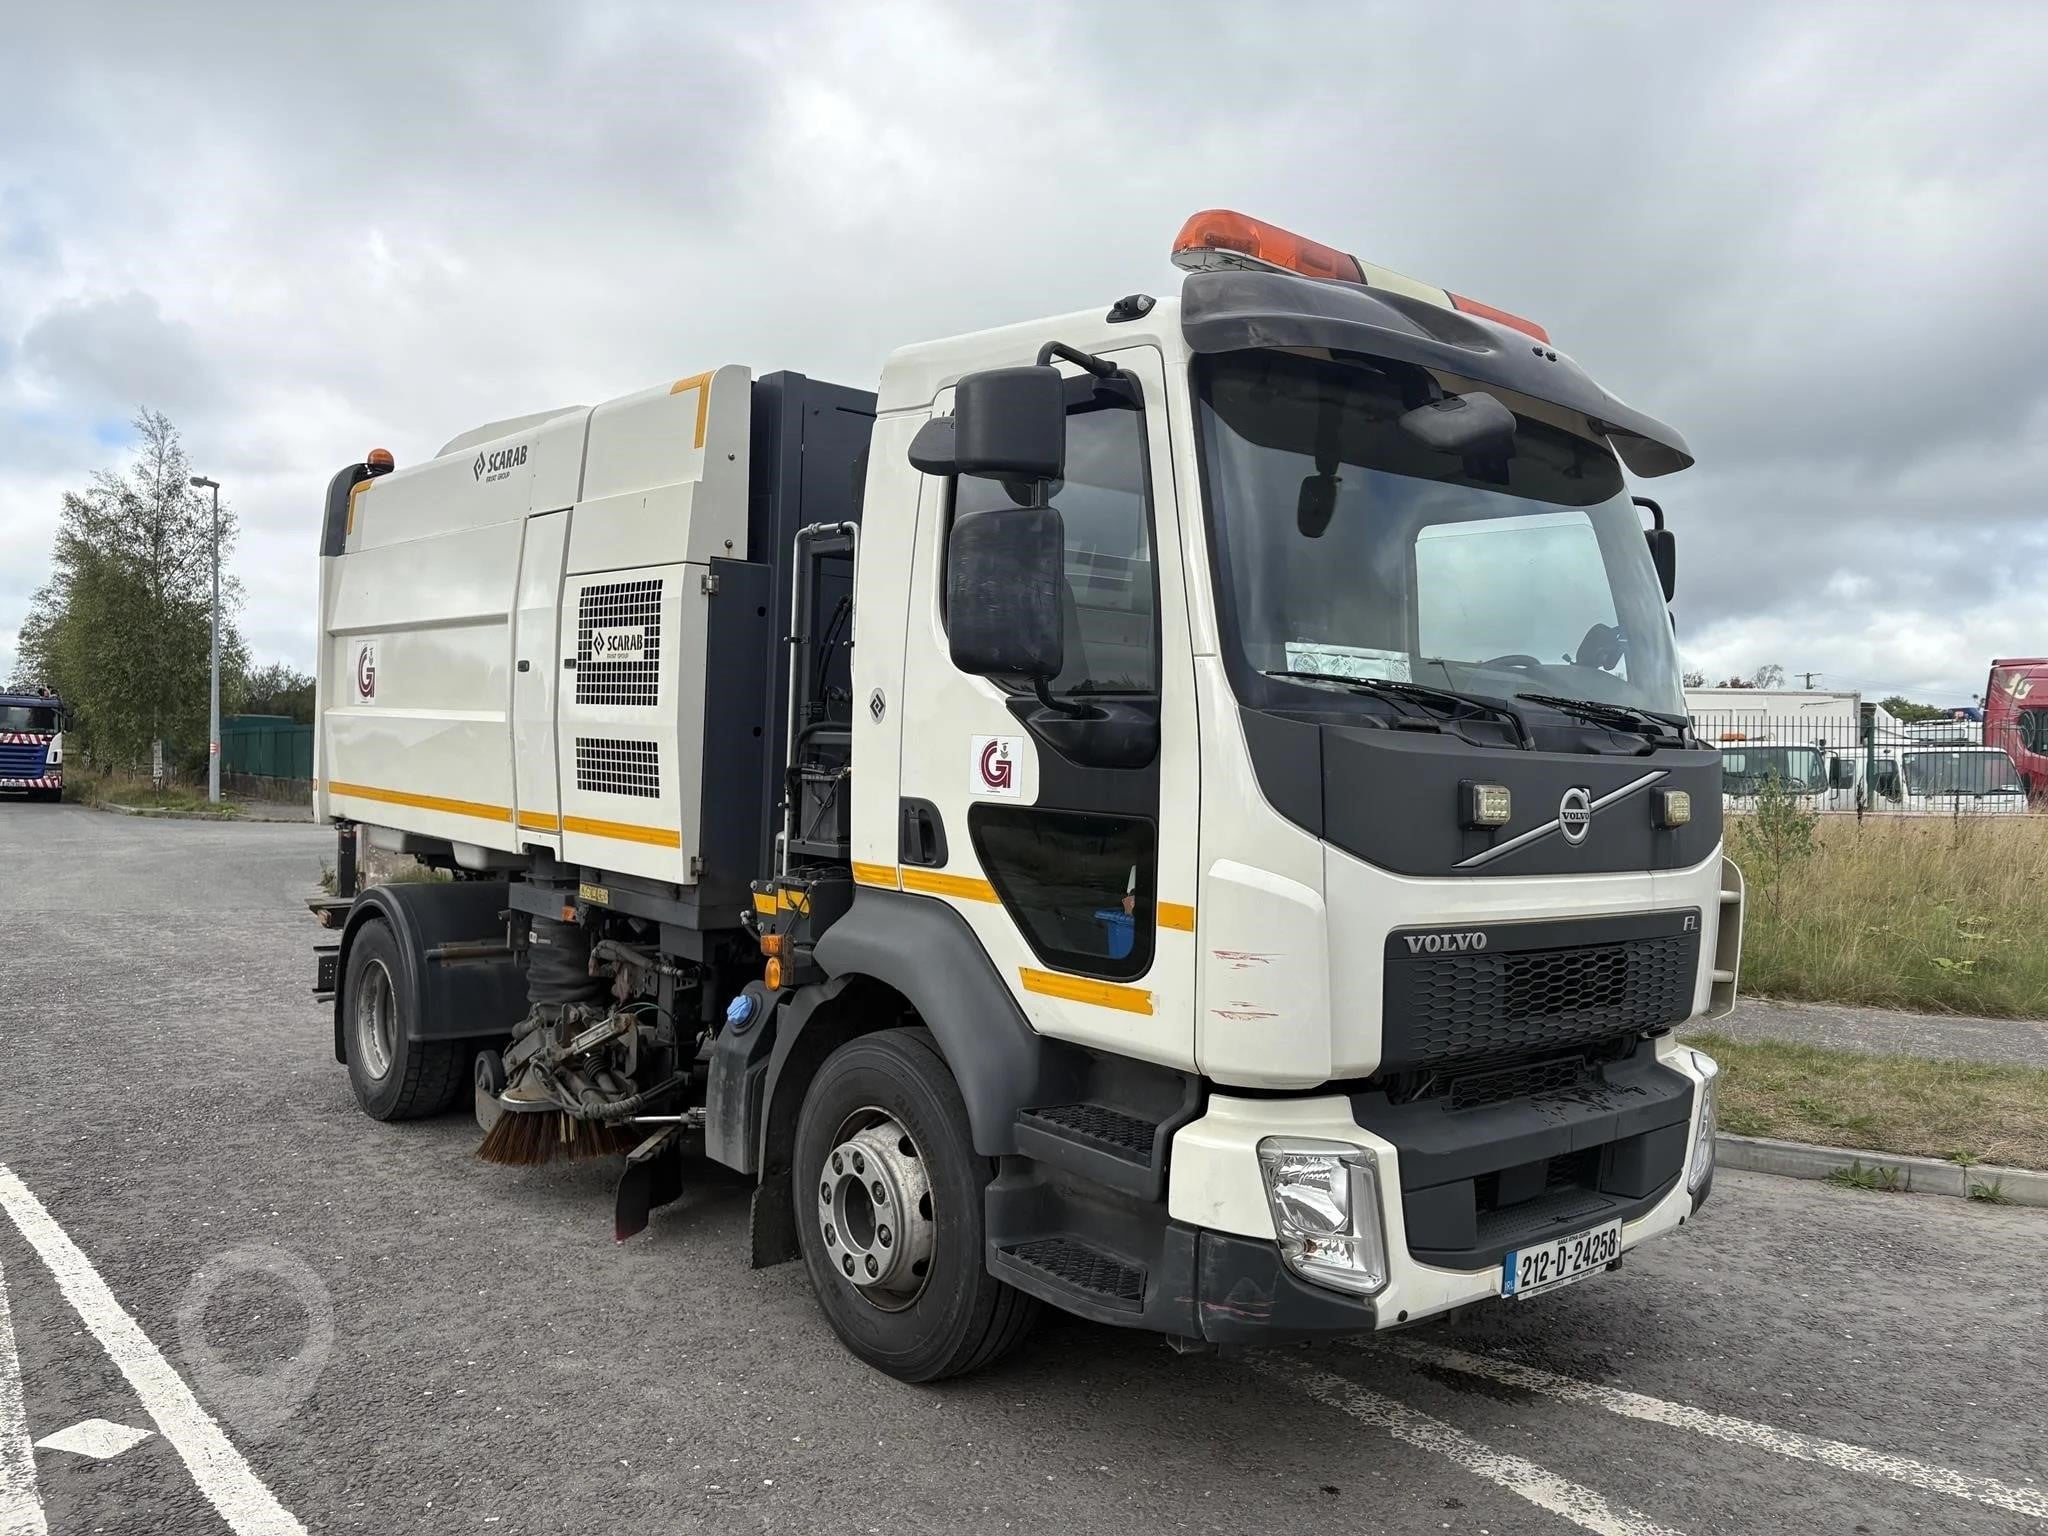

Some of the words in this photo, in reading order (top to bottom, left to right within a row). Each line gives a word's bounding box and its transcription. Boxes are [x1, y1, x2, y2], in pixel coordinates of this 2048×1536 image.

[487, 445, 528, 473] SCARAB
[607, 634, 643, 651] SCARAB
[1561, 811, 1590, 821] VOLVO
[1684, 915, 1699, 931] FL
[1403, 932, 1487, 954] VOLVO
[1521, 1228, 1617, 1288] 212-D-24258
[1504, 1281, 1515, 1291] IRL
